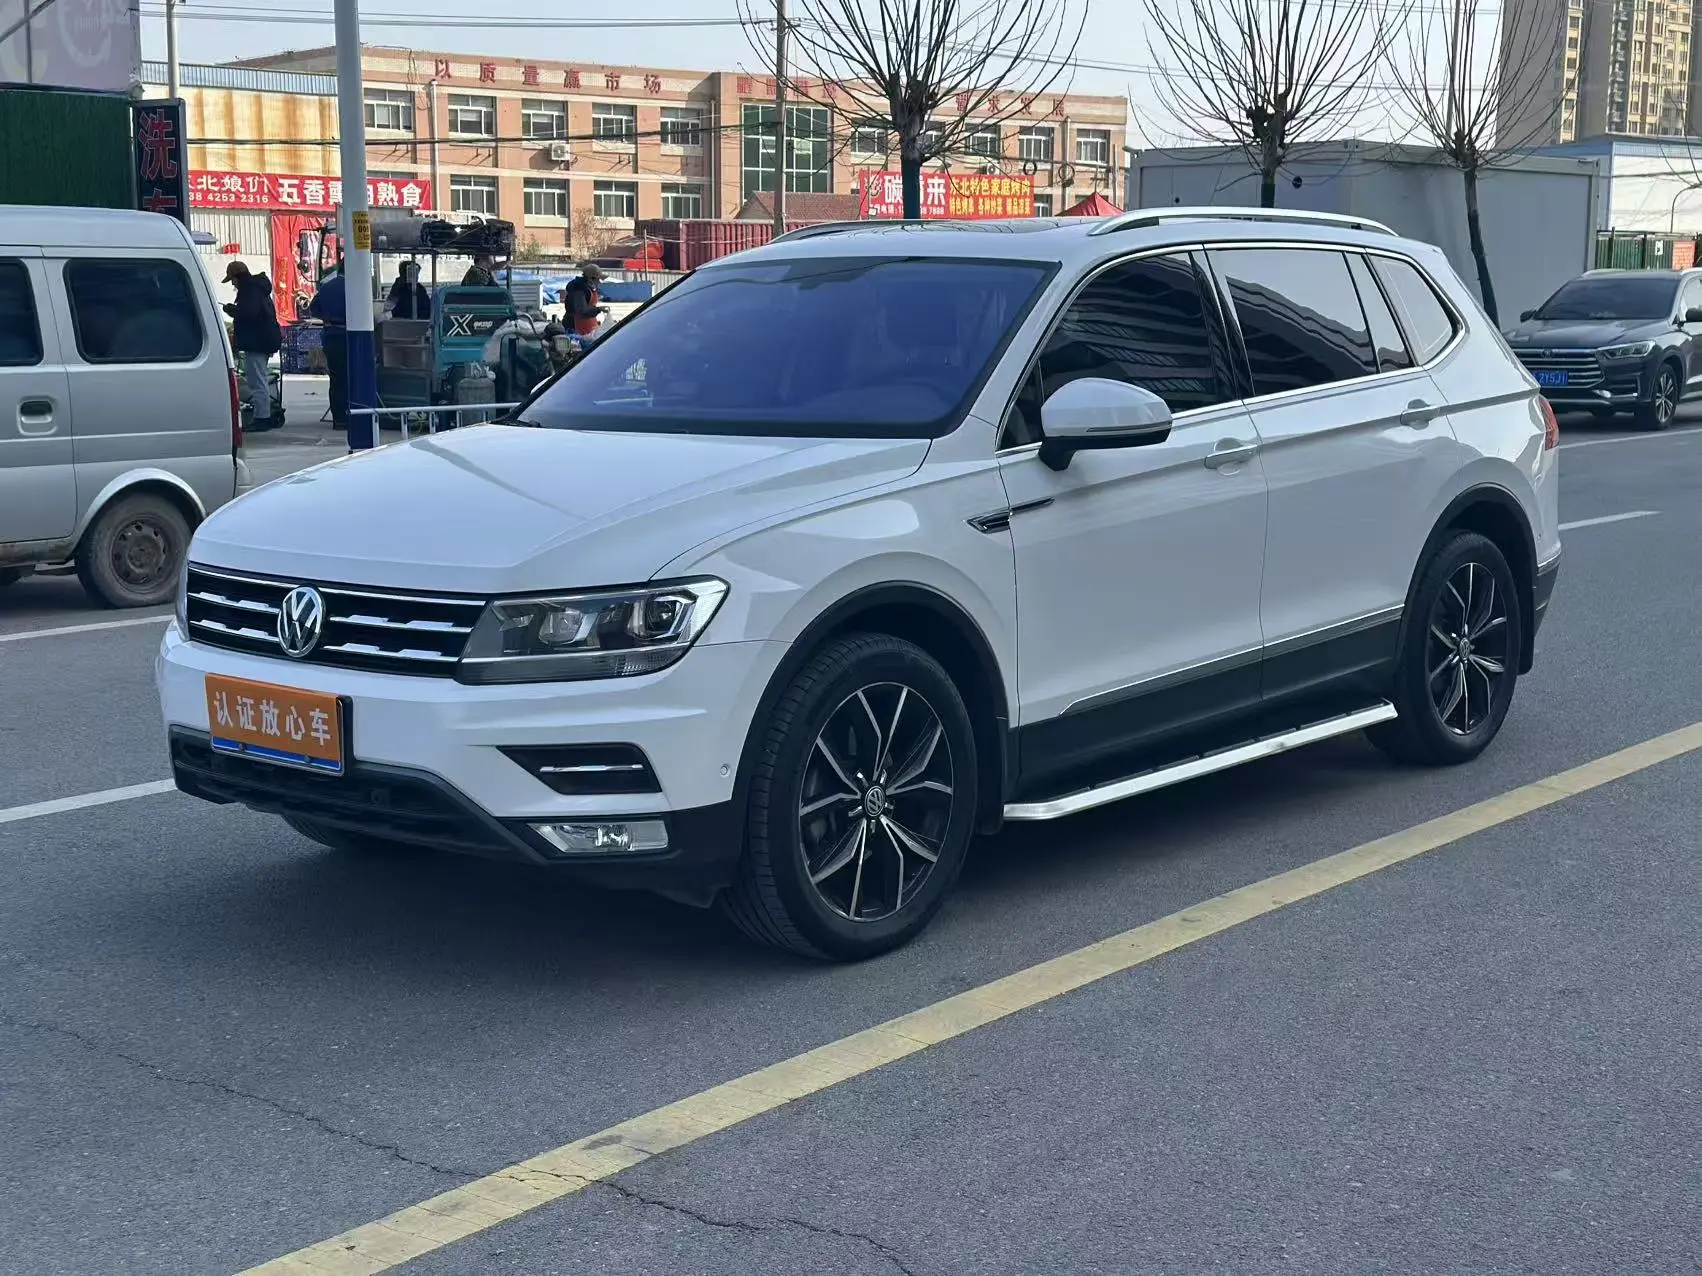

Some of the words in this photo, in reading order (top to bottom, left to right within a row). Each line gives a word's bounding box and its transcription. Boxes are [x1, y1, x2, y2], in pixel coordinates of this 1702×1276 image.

[434, 59, 661, 94] 以质量赢市场
[278, 178, 422, 208] 五香熏熟食
[213, 691, 331, 746] 认证放心车
